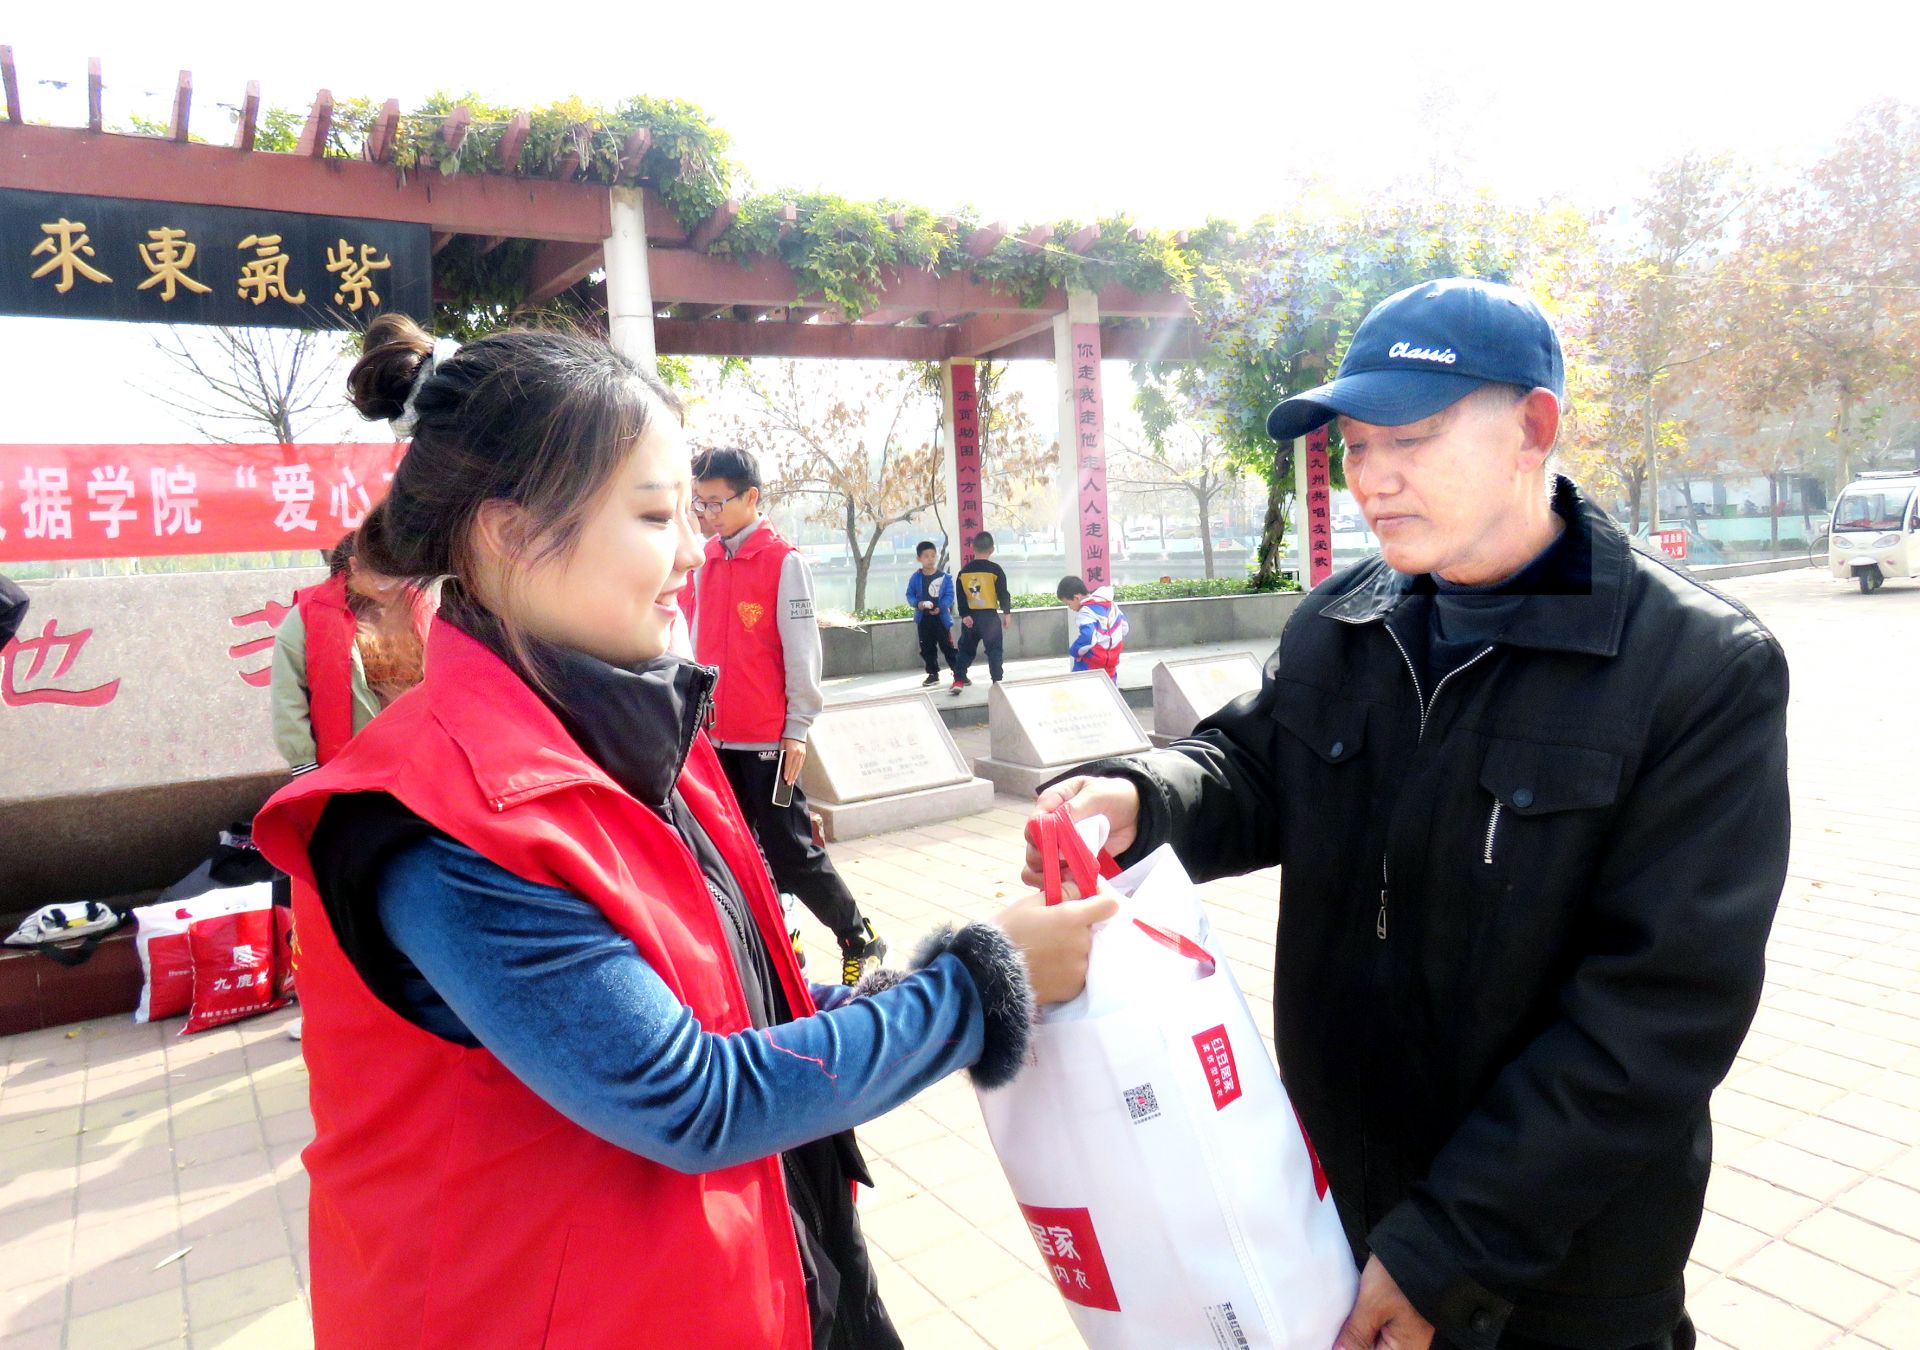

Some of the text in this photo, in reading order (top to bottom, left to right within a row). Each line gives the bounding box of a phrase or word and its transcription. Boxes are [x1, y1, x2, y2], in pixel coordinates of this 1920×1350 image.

[1389, 341, 1456, 364] Classic
[0, 463, 394, 541] 据学院“爱心
[1210, 1038, 1235, 1094] 红豆居家
